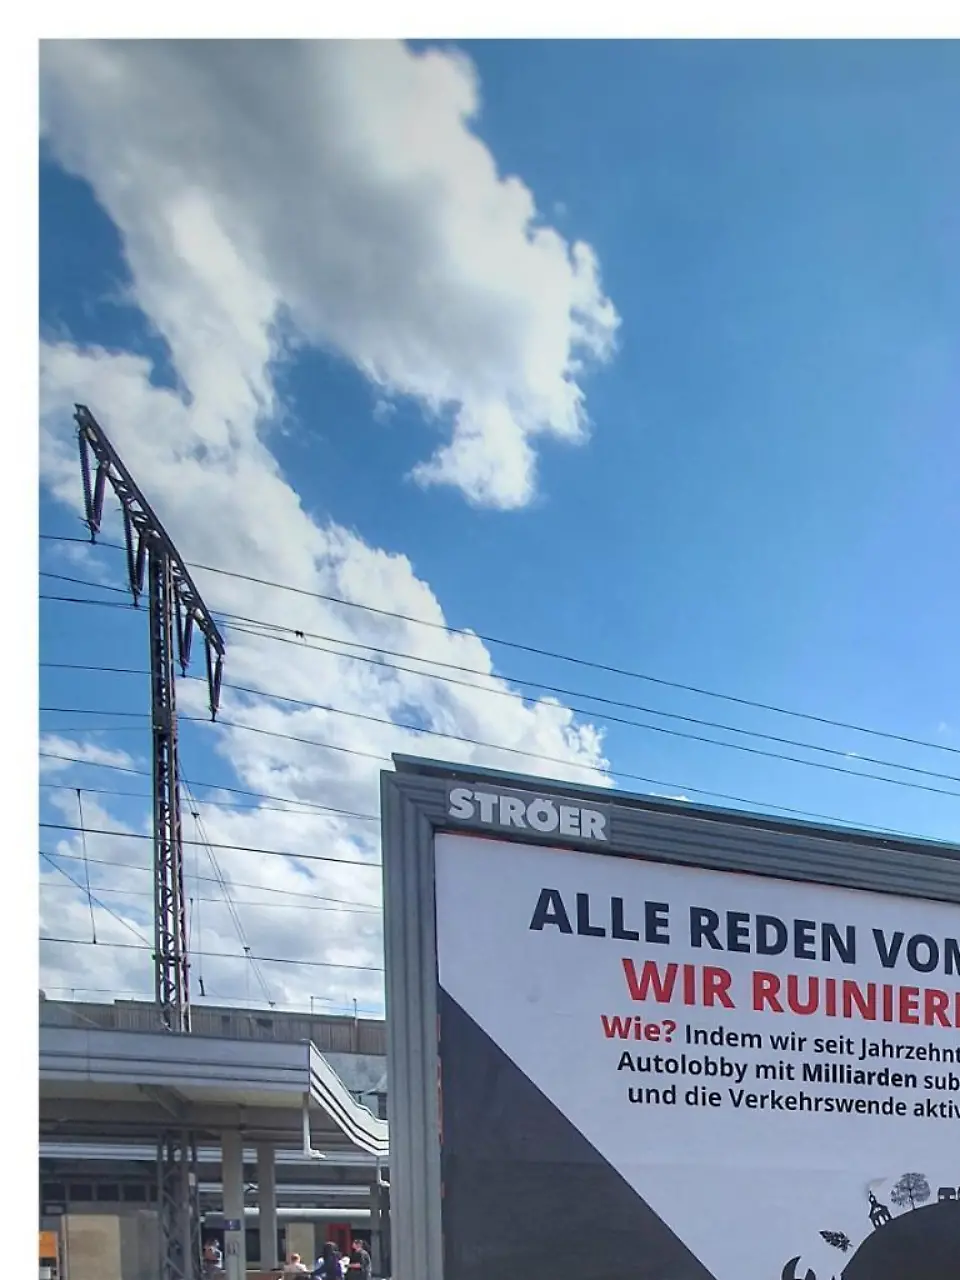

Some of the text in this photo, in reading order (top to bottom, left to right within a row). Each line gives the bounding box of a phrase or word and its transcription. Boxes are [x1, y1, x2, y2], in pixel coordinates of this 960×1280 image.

[448, 787, 607, 841] STRÖER
[528, 887, 671, 946] ALLE
[689, 905, 857, 965] REDEN
[621, 957, 736, 1009] WIR
[600, 1014, 677, 1044] Wie?
[685, 1023, 762, 1050] Indem
[769, 1030, 808, 1053] wir
[813, 1034, 855, 1056] seit
[616, 1050, 749, 1085] Autolobby
[755, 1059, 796, 1081] mit
[802, 1062, 918, 1089] Milliarden
[627, 1083, 677, 1106] und
[684, 1085, 722, 1108] die
[727, 1087, 907, 1117] Verkehrswende
